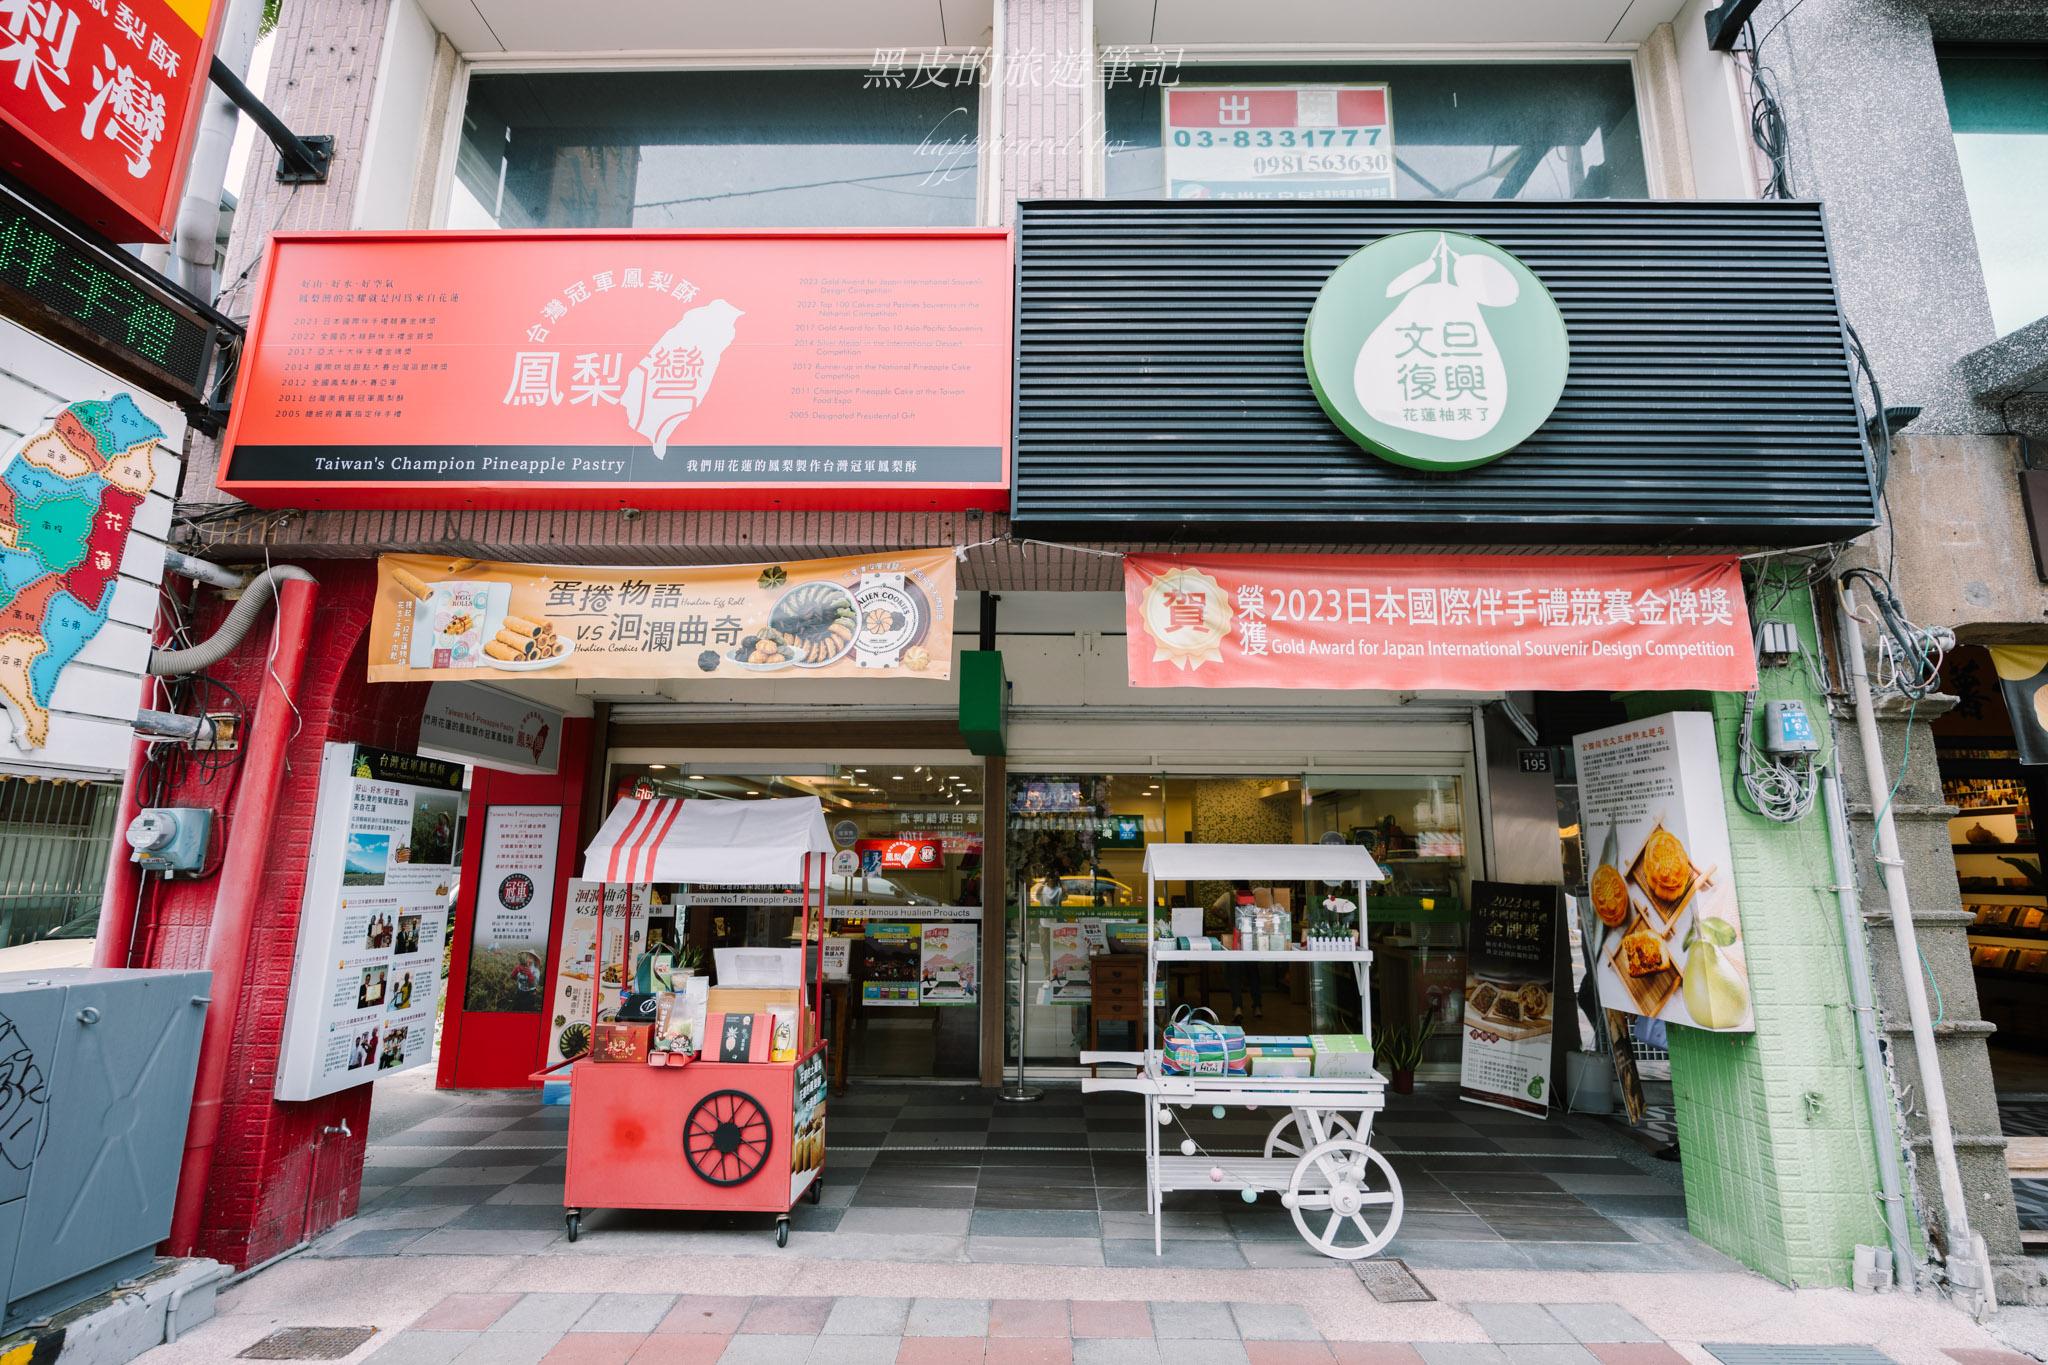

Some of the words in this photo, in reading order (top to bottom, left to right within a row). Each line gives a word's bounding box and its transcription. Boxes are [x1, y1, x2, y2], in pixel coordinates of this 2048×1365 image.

[1174, 128, 1382, 149] 03-8331777
[1253, 154, 1388, 174] 0981563630
[526, 268, 700, 343] 台灣冠軍鳳梨酥
[1394, 321, 1483, 358] 文旦
[284, 363, 309, 371] 2014
[1396, 363, 1488, 402] 復興
[278, 394, 303, 402] 2011
[275, 410, 300, 418] 2005
[1402, 407, 1489, 422] 花蓮柚來了
[315, 457, 385, 471] Taiwan's
[391, 457, 475, 473] Champion
[482, 457, 566, 473] Pineapple
[571, 458, 625, 473] Pastry
[686, 459, 917, 473] 我們用花蓮的鳳梨製作台灣冠軍鳳梨酥
[545, 580, 686, 612] 蛋捲物語
[713, 598, 726, 608] Egg
[728, 597, 745, 605] Roll
[1162, 588, 1210, 634] 賀
[1270, 587, 1734, 627] 2023日本國際伴手禮競賽金牌獎
[1236, 584, 1269, 657] 榮獲
[608, 612, 743, 652] 洄瀾曲奇
[1272, 639, 1305, 655] Gold
[1308, 639, 1355, 656] Award
[1357, 639, 1379, 656] for
[1382, 639, 1425, 660] Japan
[1428, 640, 1522, 657] International
[1525, 640, 1590, 657] Souvenir
[1592, 640, 1642, 660] Design
[1645, 640, 1734, 660] Competition
[1524, 759, 1546, 771] 195
[740, 896, 781, 905] Pineapple
[868, 907, 898, 916] famous
[900, 908, 932, 916] Hualien
[933, 908, 970, 917] Products
